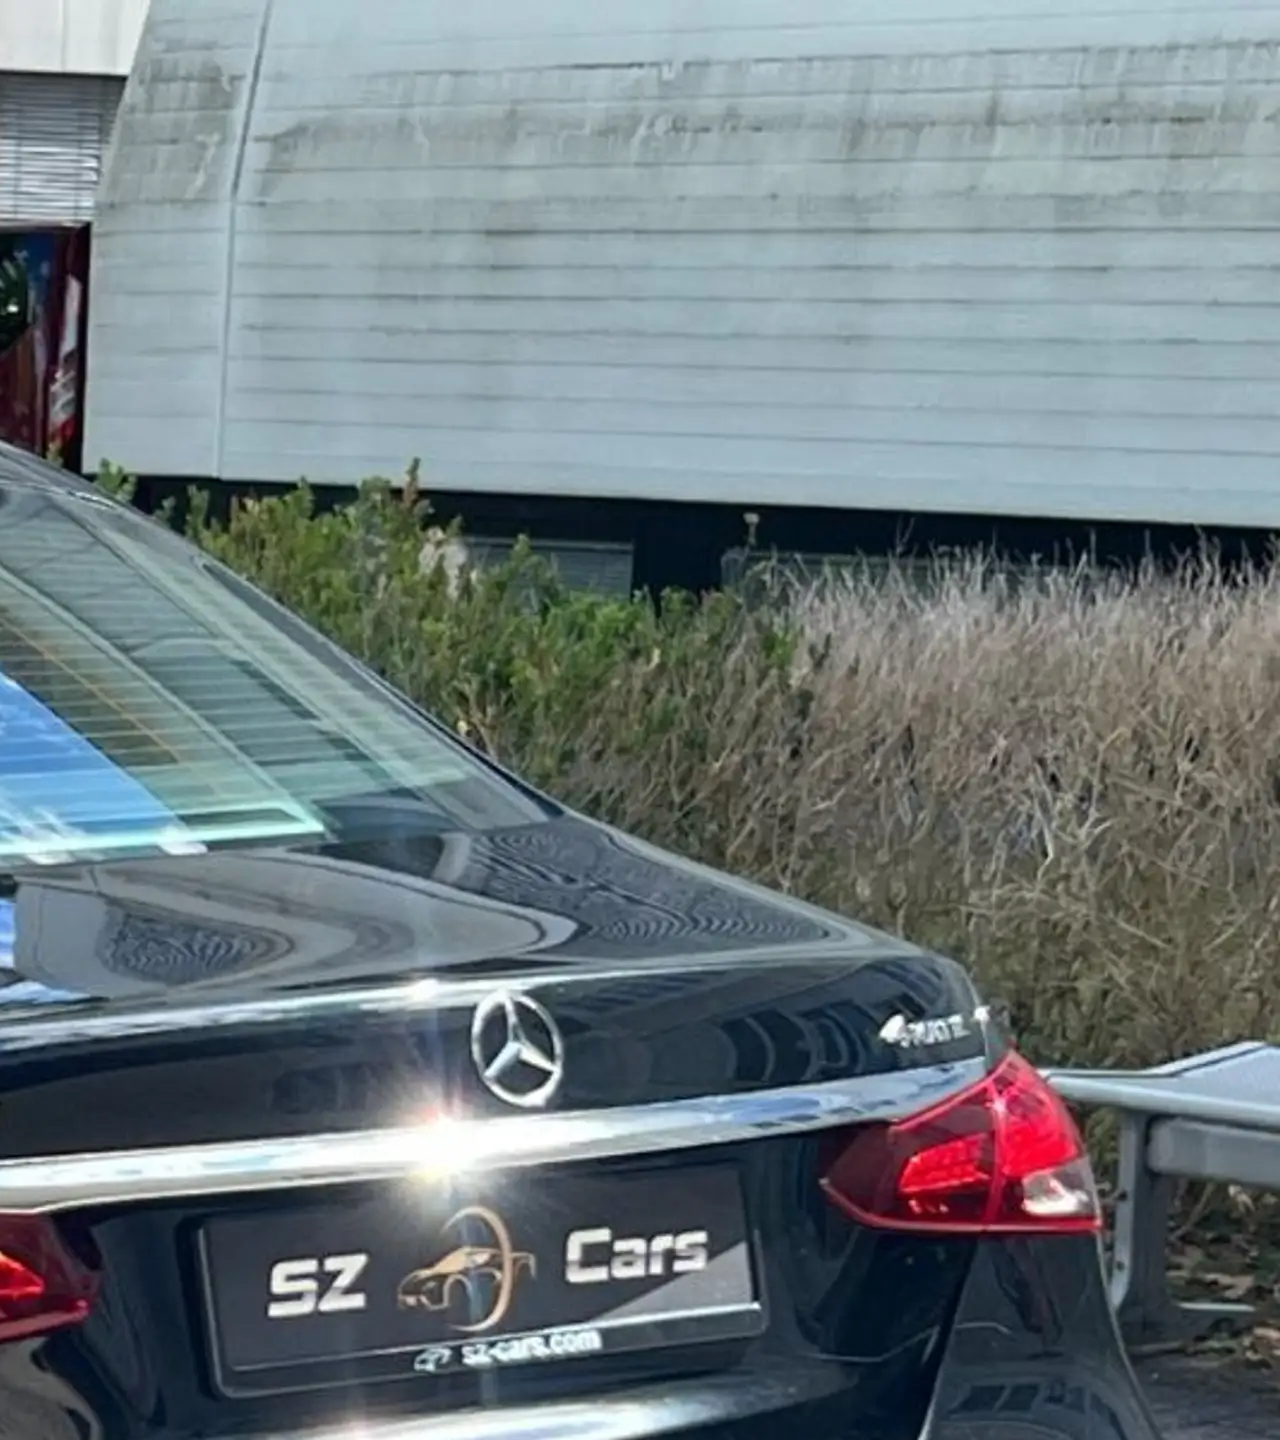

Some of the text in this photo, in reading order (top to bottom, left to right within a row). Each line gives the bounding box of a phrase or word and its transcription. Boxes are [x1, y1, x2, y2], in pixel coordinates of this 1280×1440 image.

[267, 1226, 710, 1318] SZ Cars
[460, 1330, 603, 1368] sz-cars.com
